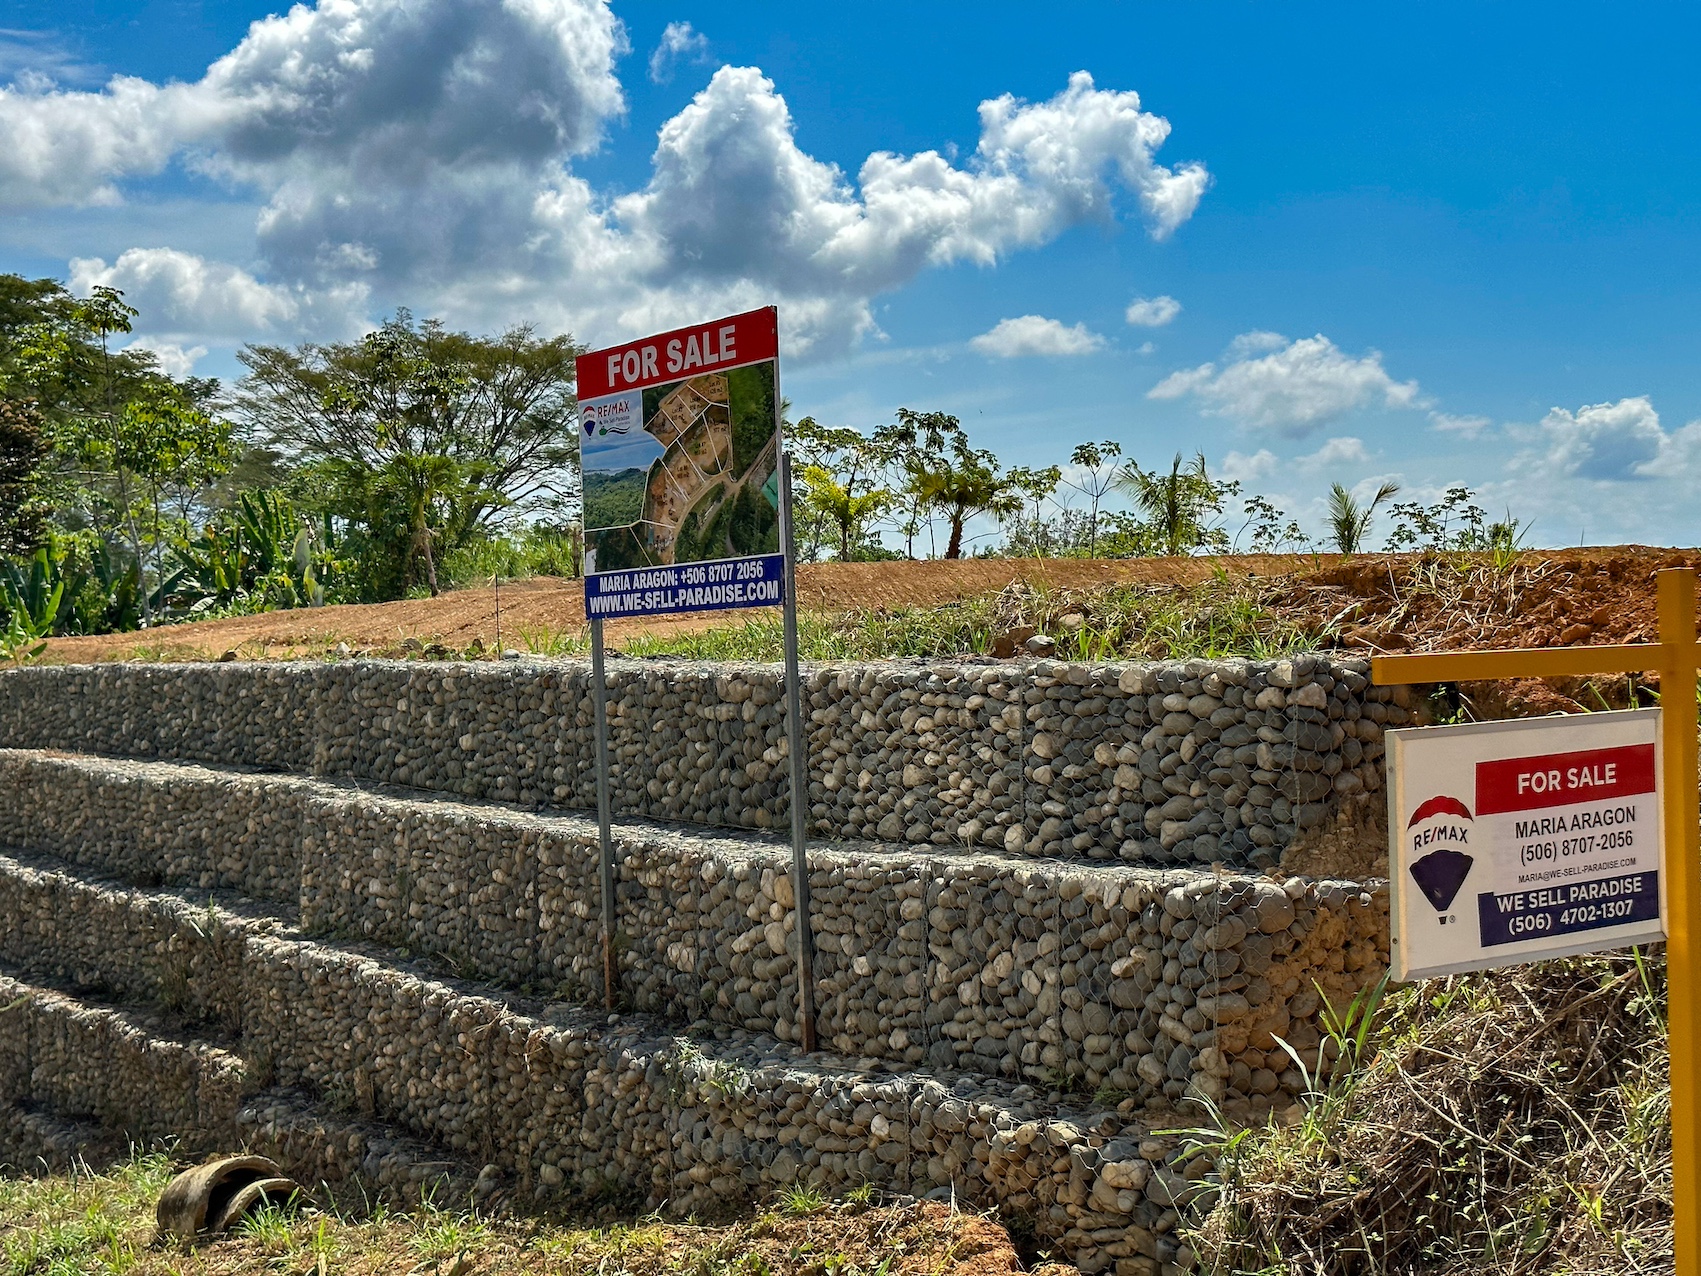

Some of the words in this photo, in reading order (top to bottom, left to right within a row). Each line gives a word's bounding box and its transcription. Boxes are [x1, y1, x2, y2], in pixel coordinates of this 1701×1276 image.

[607, 345, 659, 388] FOR
[666, 325, 737, 373] SALE
[597, 400, 630, 418] RE/MAX
[600, 572, 631, 593] MARIA
[632, 569, 678, 590] ARAGON:
[680, 567, 706, 584] +506
[708, 564, 734, 582] 8707
[737, 560, 764, 580] 2056
[589, 580, 779, 614] WWW.WE-SELL-PARADISE.COM
[1518, 770, 1561, 794] FOR
[1567, 763, 1617, 789] SALE
[1413, 825, 1468, 851] RE/MAX
[1515, 816, 1568, 839] MARIA
[1570, 805, 1636, 832] ARAGON
[1521, 841, 1557, 867] (506)
[1562, 830, 1633, 856] 8707-2056
[1518, 857, 1637, 884] MARIA@WE-SELL-PARADISE.COM
[1496, 894, 1525, 913] WE
[1528, 889, 1566, 909] SELL
[1570, 877, 1643, 903] PARADISE
[1508, 913, 1552, 936] (506)
[1560, 899, 1634, 925] 4702-1307
